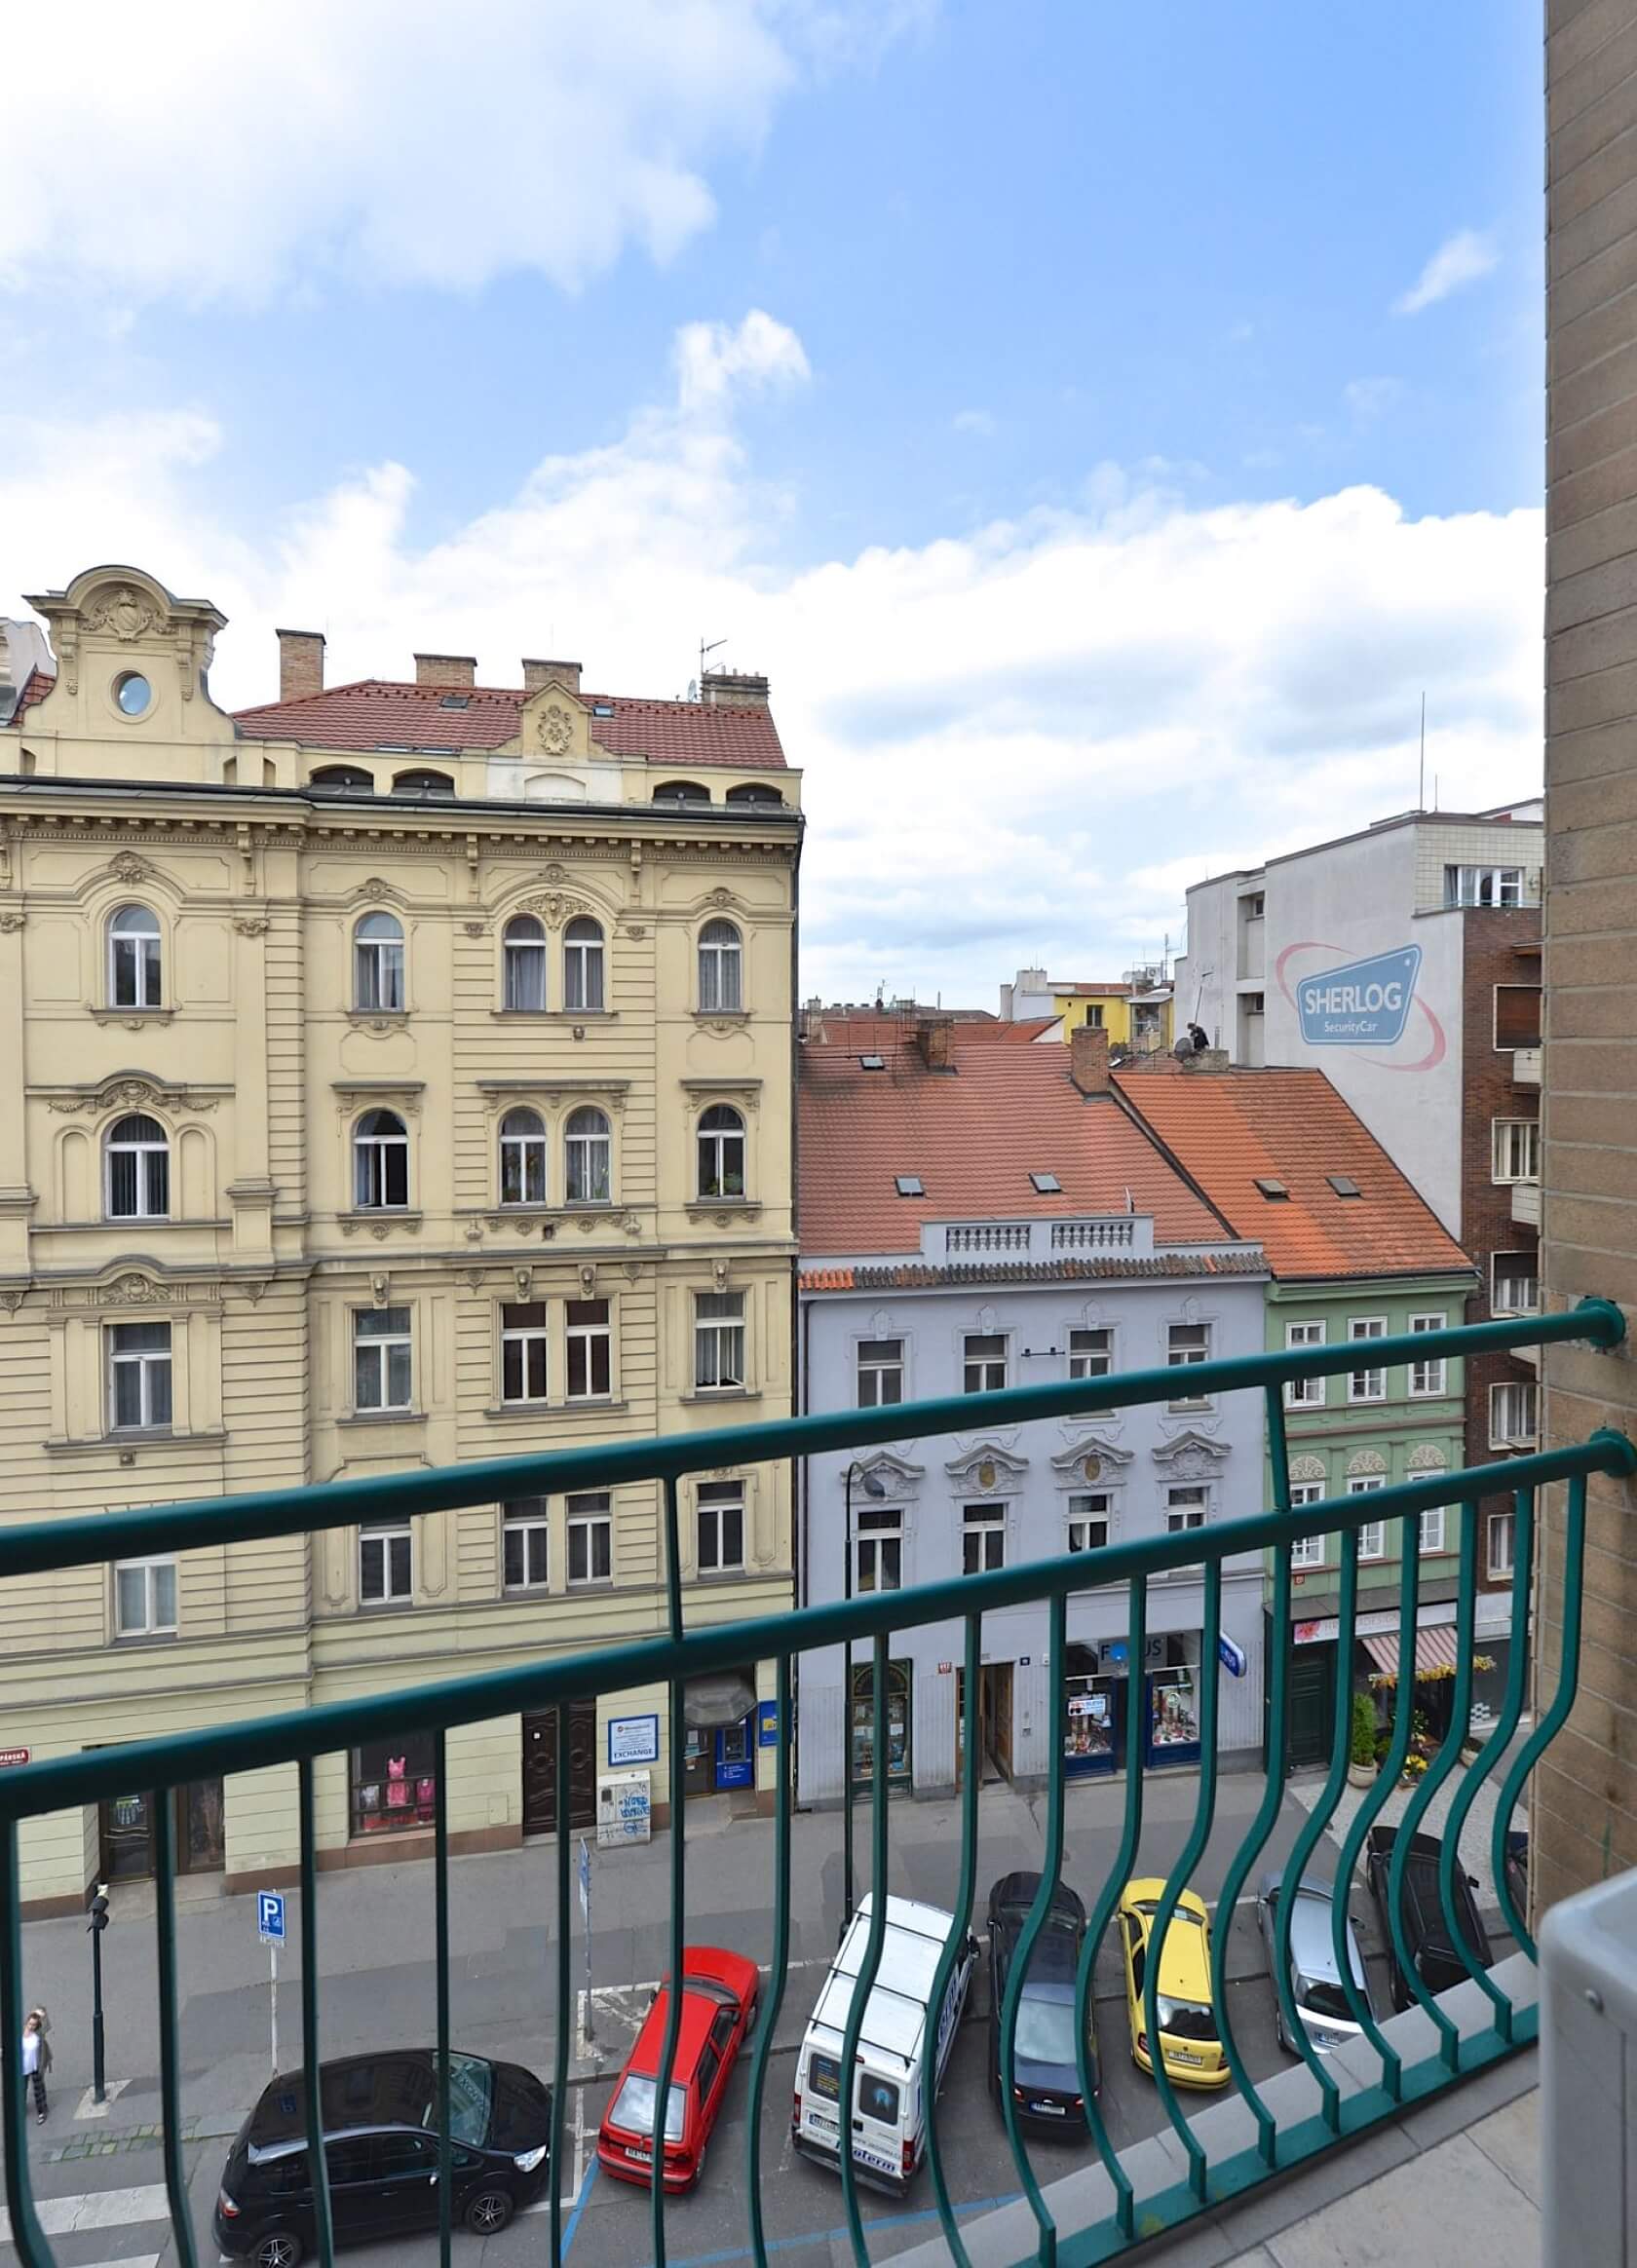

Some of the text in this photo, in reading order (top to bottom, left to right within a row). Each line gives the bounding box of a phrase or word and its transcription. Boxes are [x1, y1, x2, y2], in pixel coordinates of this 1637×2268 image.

[1305, 981, 1402, 1014] SHERLOG
[613, 1748, 653, 1759] EXCHANGE
[263, 1898, 279, 1921] P
